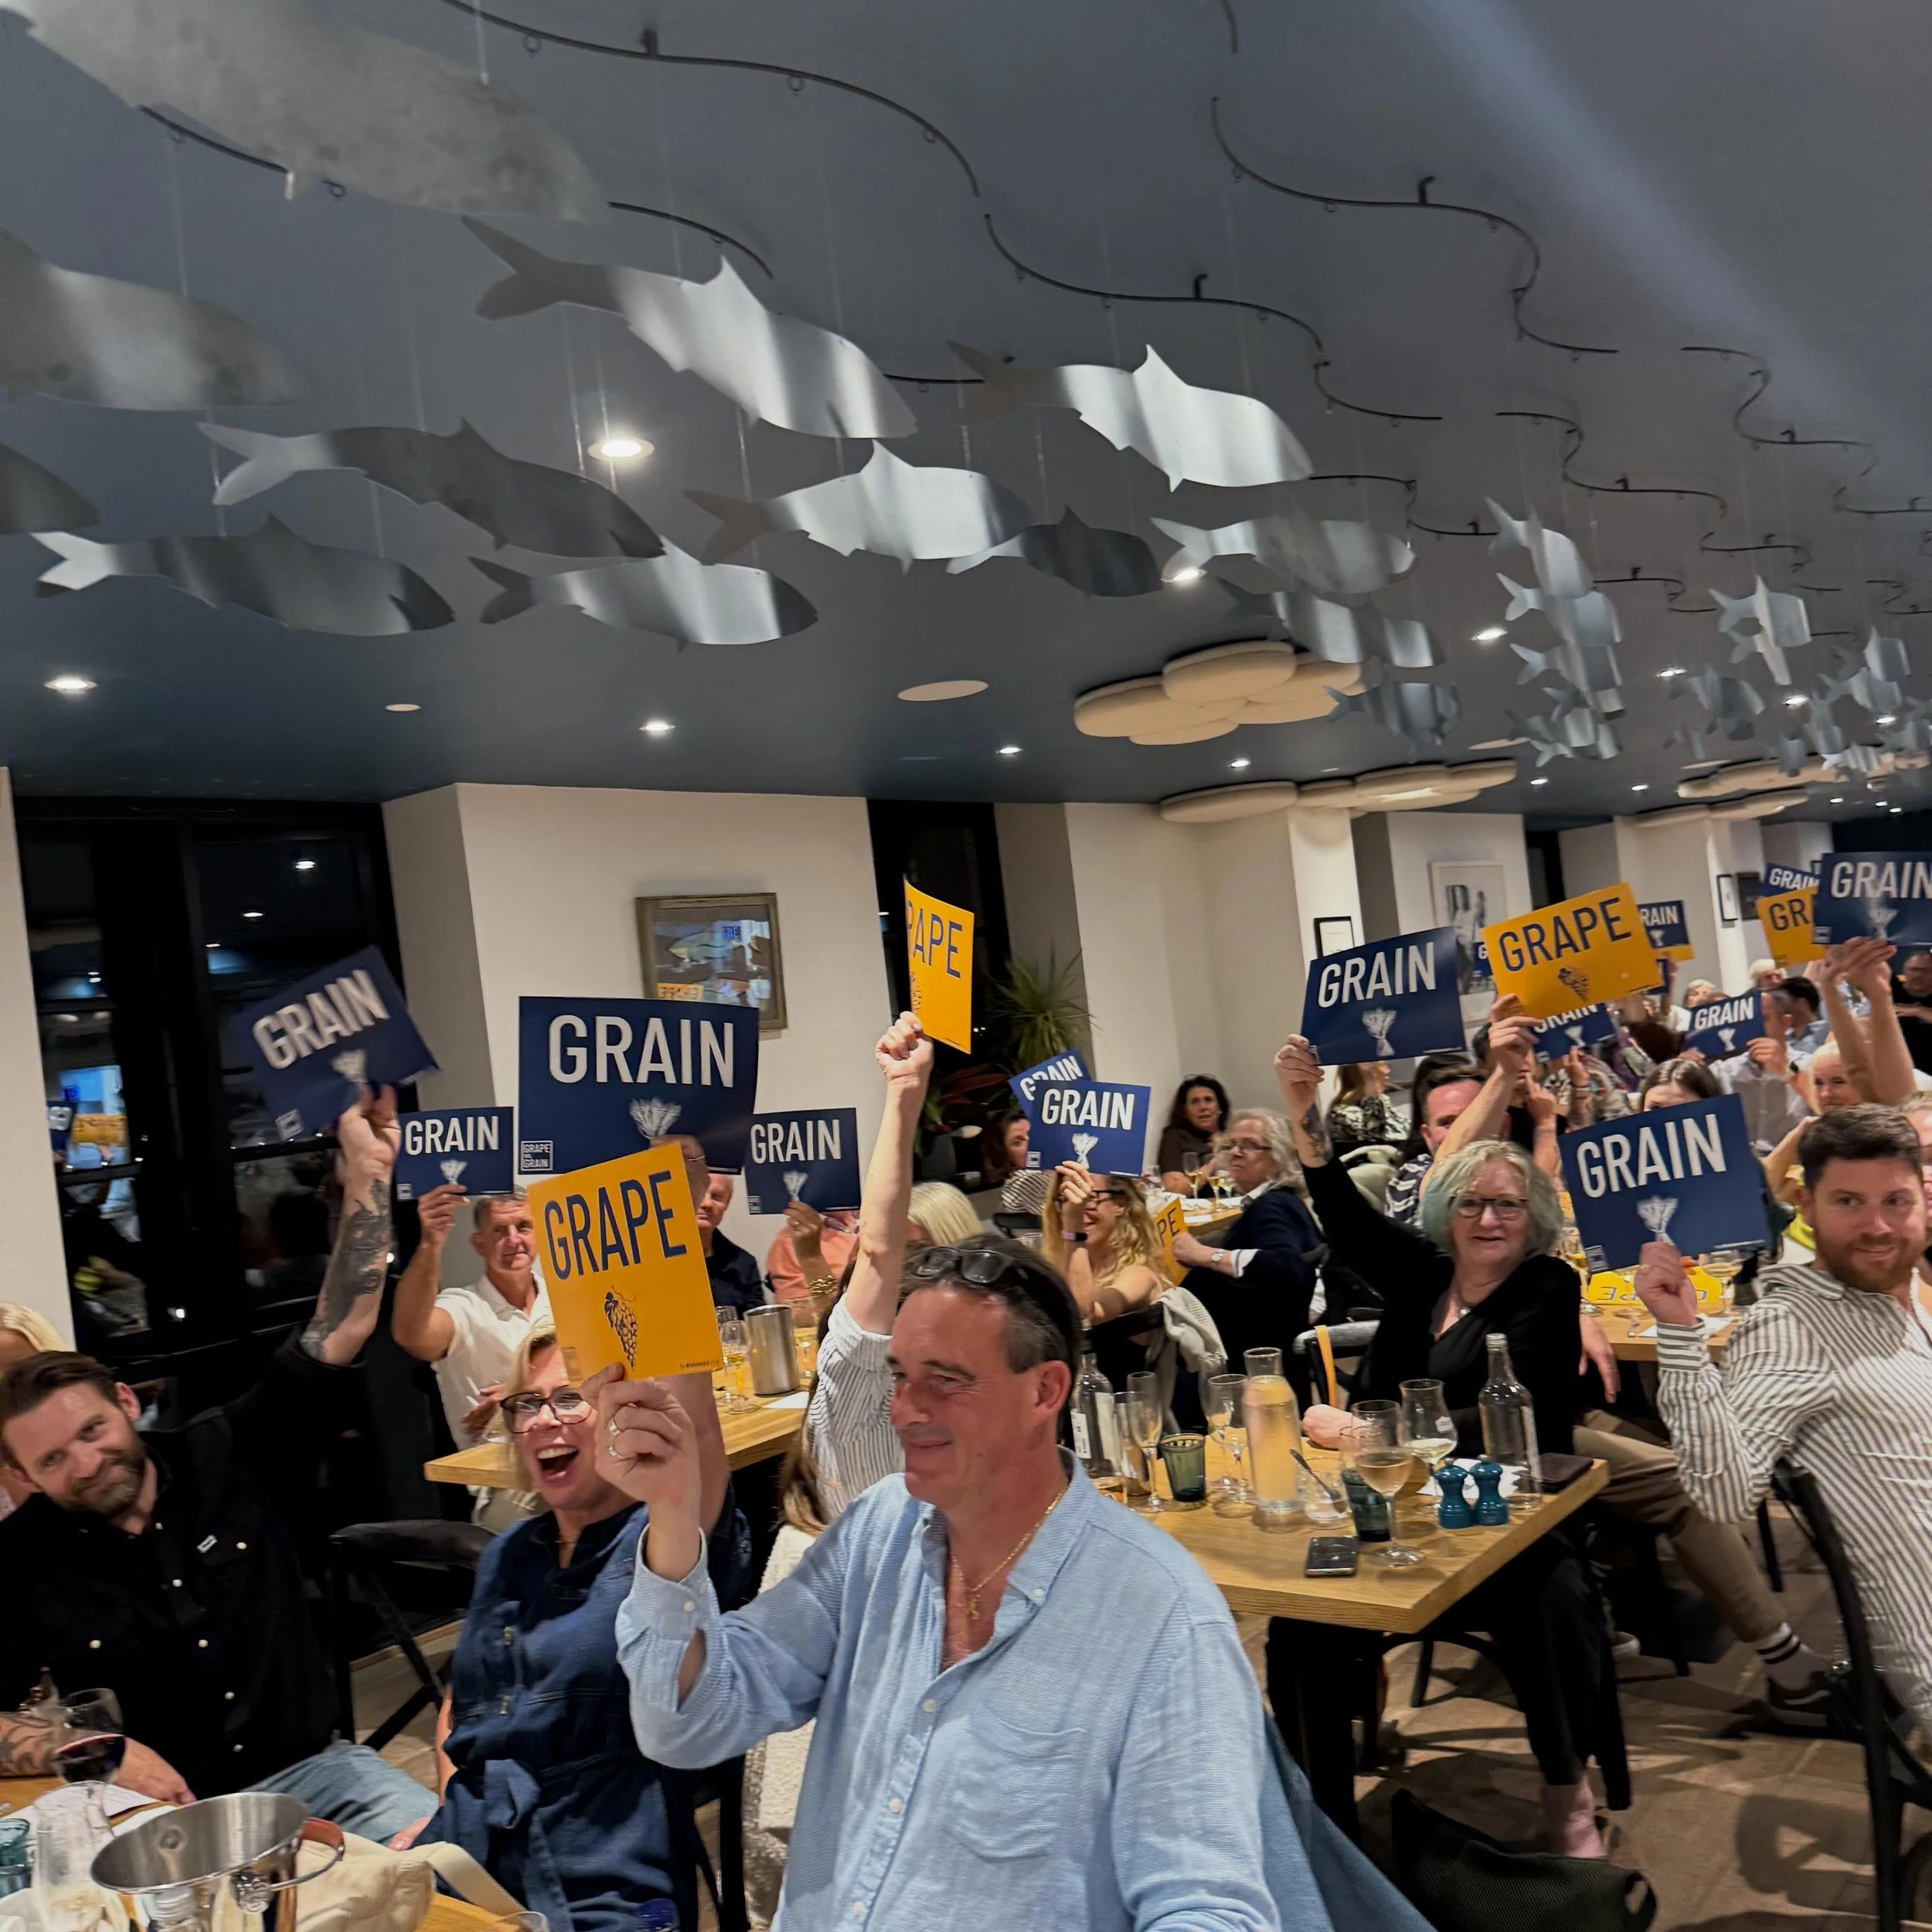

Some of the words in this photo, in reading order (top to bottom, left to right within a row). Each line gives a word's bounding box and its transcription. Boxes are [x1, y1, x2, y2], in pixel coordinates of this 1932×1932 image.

[1831, 862, 1932, 899] GRAIN
[906, 900, 963, 978] RAPE
[1499, 897, 1631, 972] GRAPE
[1640, 906, 1679, 927] RAIN
[1318, 942, 1437, 1008] GRAIN
[253, 969, 389, 1070] GRAIN
[1694, 997, 1755, 1030] GRAIN
[549, 1015, 733, 1087] GRAIN
[405, 1116, 498, 1155] GRAIN
[750, 1119, 842, 1164] GRAIN
[1043, 1088, 1135, 1131] GRAIN
[1576, 1114, 1726, 1199] GRAIN
[544, 1170, 687, 1281] GRAPE
